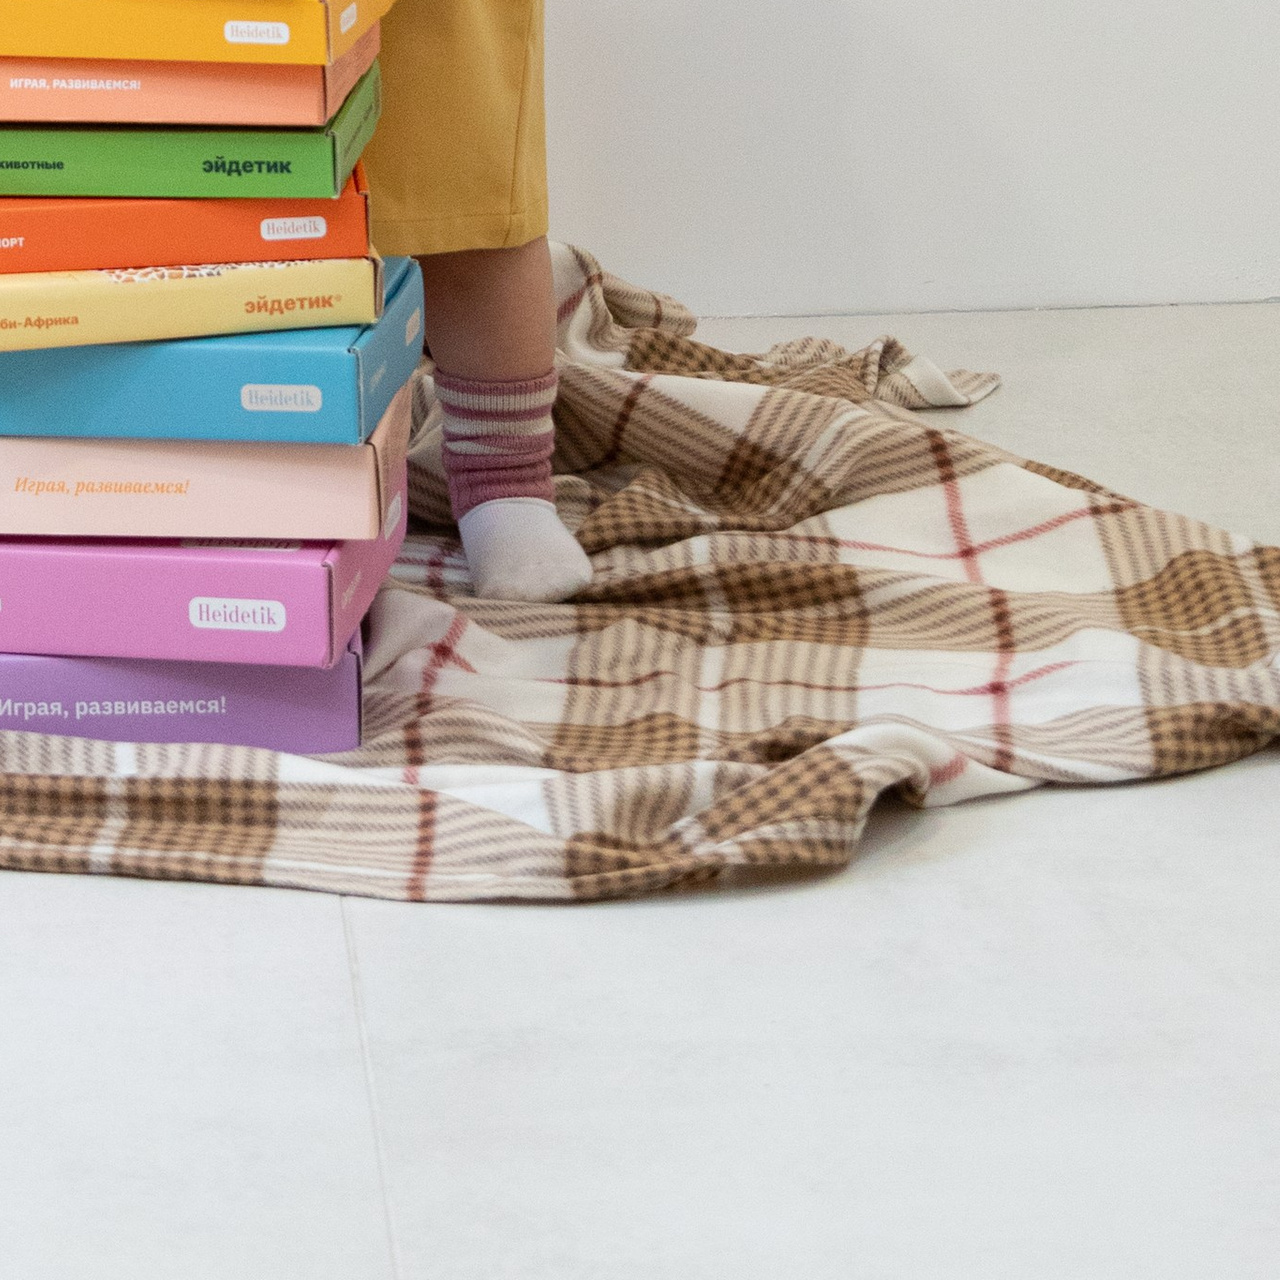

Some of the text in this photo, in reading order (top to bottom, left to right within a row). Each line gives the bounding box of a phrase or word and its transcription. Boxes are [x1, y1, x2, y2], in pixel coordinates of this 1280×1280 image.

[230, 23, 283, 41] Heidetik
[10, 78, 141, 91] ИГРАЯ, РАЗВИВАЕМСЯ!
[202, 156, 292, 176] эйдетик
[266, 220, 321, 236] Heidetik
[248, 390, 314, 406] Heidetik
[14, 476, 190, 497] Играя, развиваемся!
[197, 602, 277, 625] Heidetik
[75, 697, 227, 719] развиваемся!
